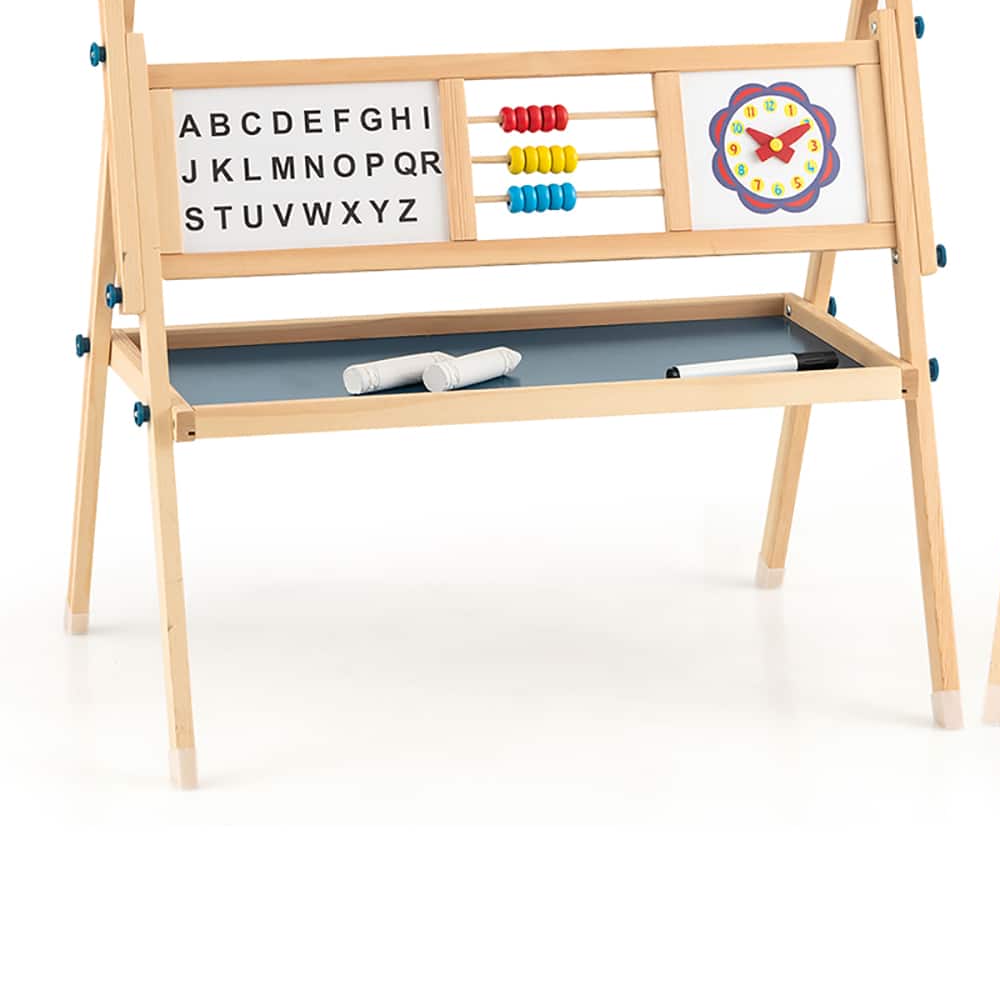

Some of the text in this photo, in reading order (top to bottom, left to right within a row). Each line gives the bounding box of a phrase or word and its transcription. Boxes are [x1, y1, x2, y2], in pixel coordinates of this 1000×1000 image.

[746, 105, 756, 118] 11
[764, 99, 776, 112] 12
[788, 104, 794, 117] 1
[178, 105, 430, 139] A B C D E F G H I
[732, 122, 744, 134] 10
[729, 143, 738, 155] 9
[810, 139, 819, 152] 3
[181, 150, 443, 184] J K L M N O P Q R
[737, 163, 746, 177] 8
[753, 178, 762, 191] 7
[793, 176, 802, 190] 5
[774, 184, 783, 196] 6
[185, 198, 418, 232] S T U V W X Y Z
